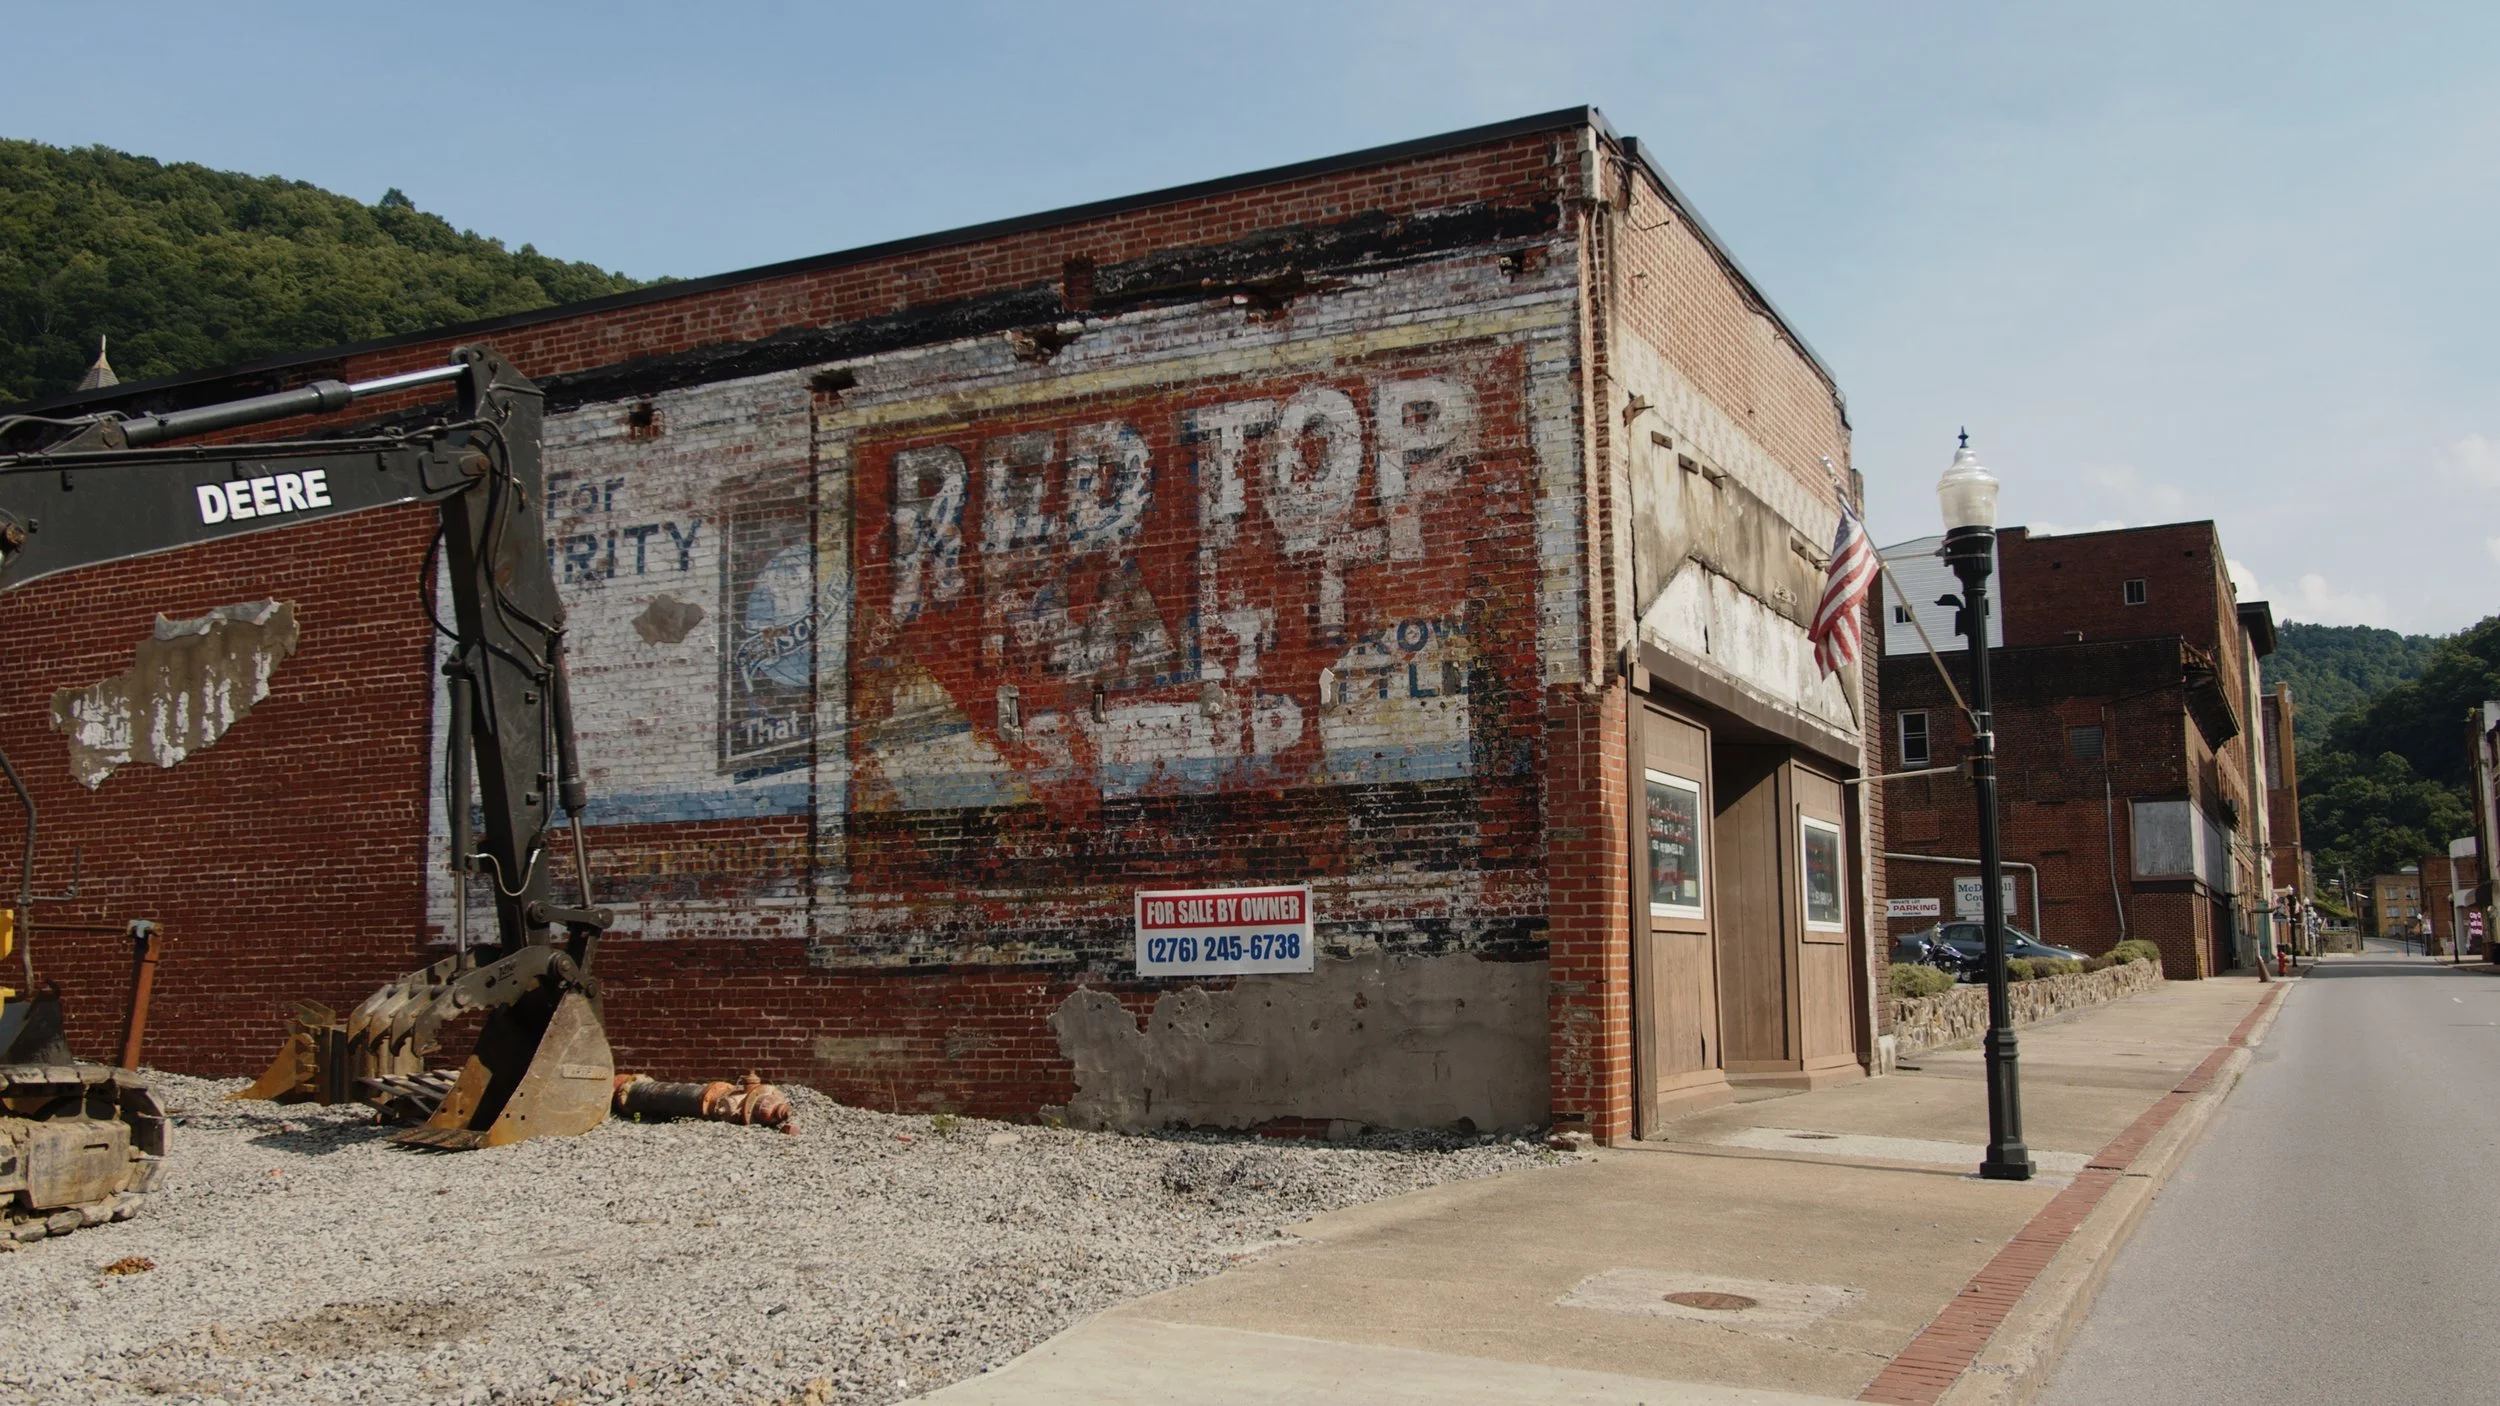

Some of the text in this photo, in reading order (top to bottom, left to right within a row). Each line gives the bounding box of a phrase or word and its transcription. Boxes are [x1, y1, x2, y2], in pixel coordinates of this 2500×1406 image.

[1182, 378, 1477, 545] TOP
[195, 468, 332, 525] DEERE
[547, 470, 625, 520] For
[740, 709, 800, 746] That
[1958, 882, 2013, 892] McDll
[1146, 895, 1300, 925] FOR SALE BY OWNER
[1147, 933, 1301, 963] (276) 245-6738
